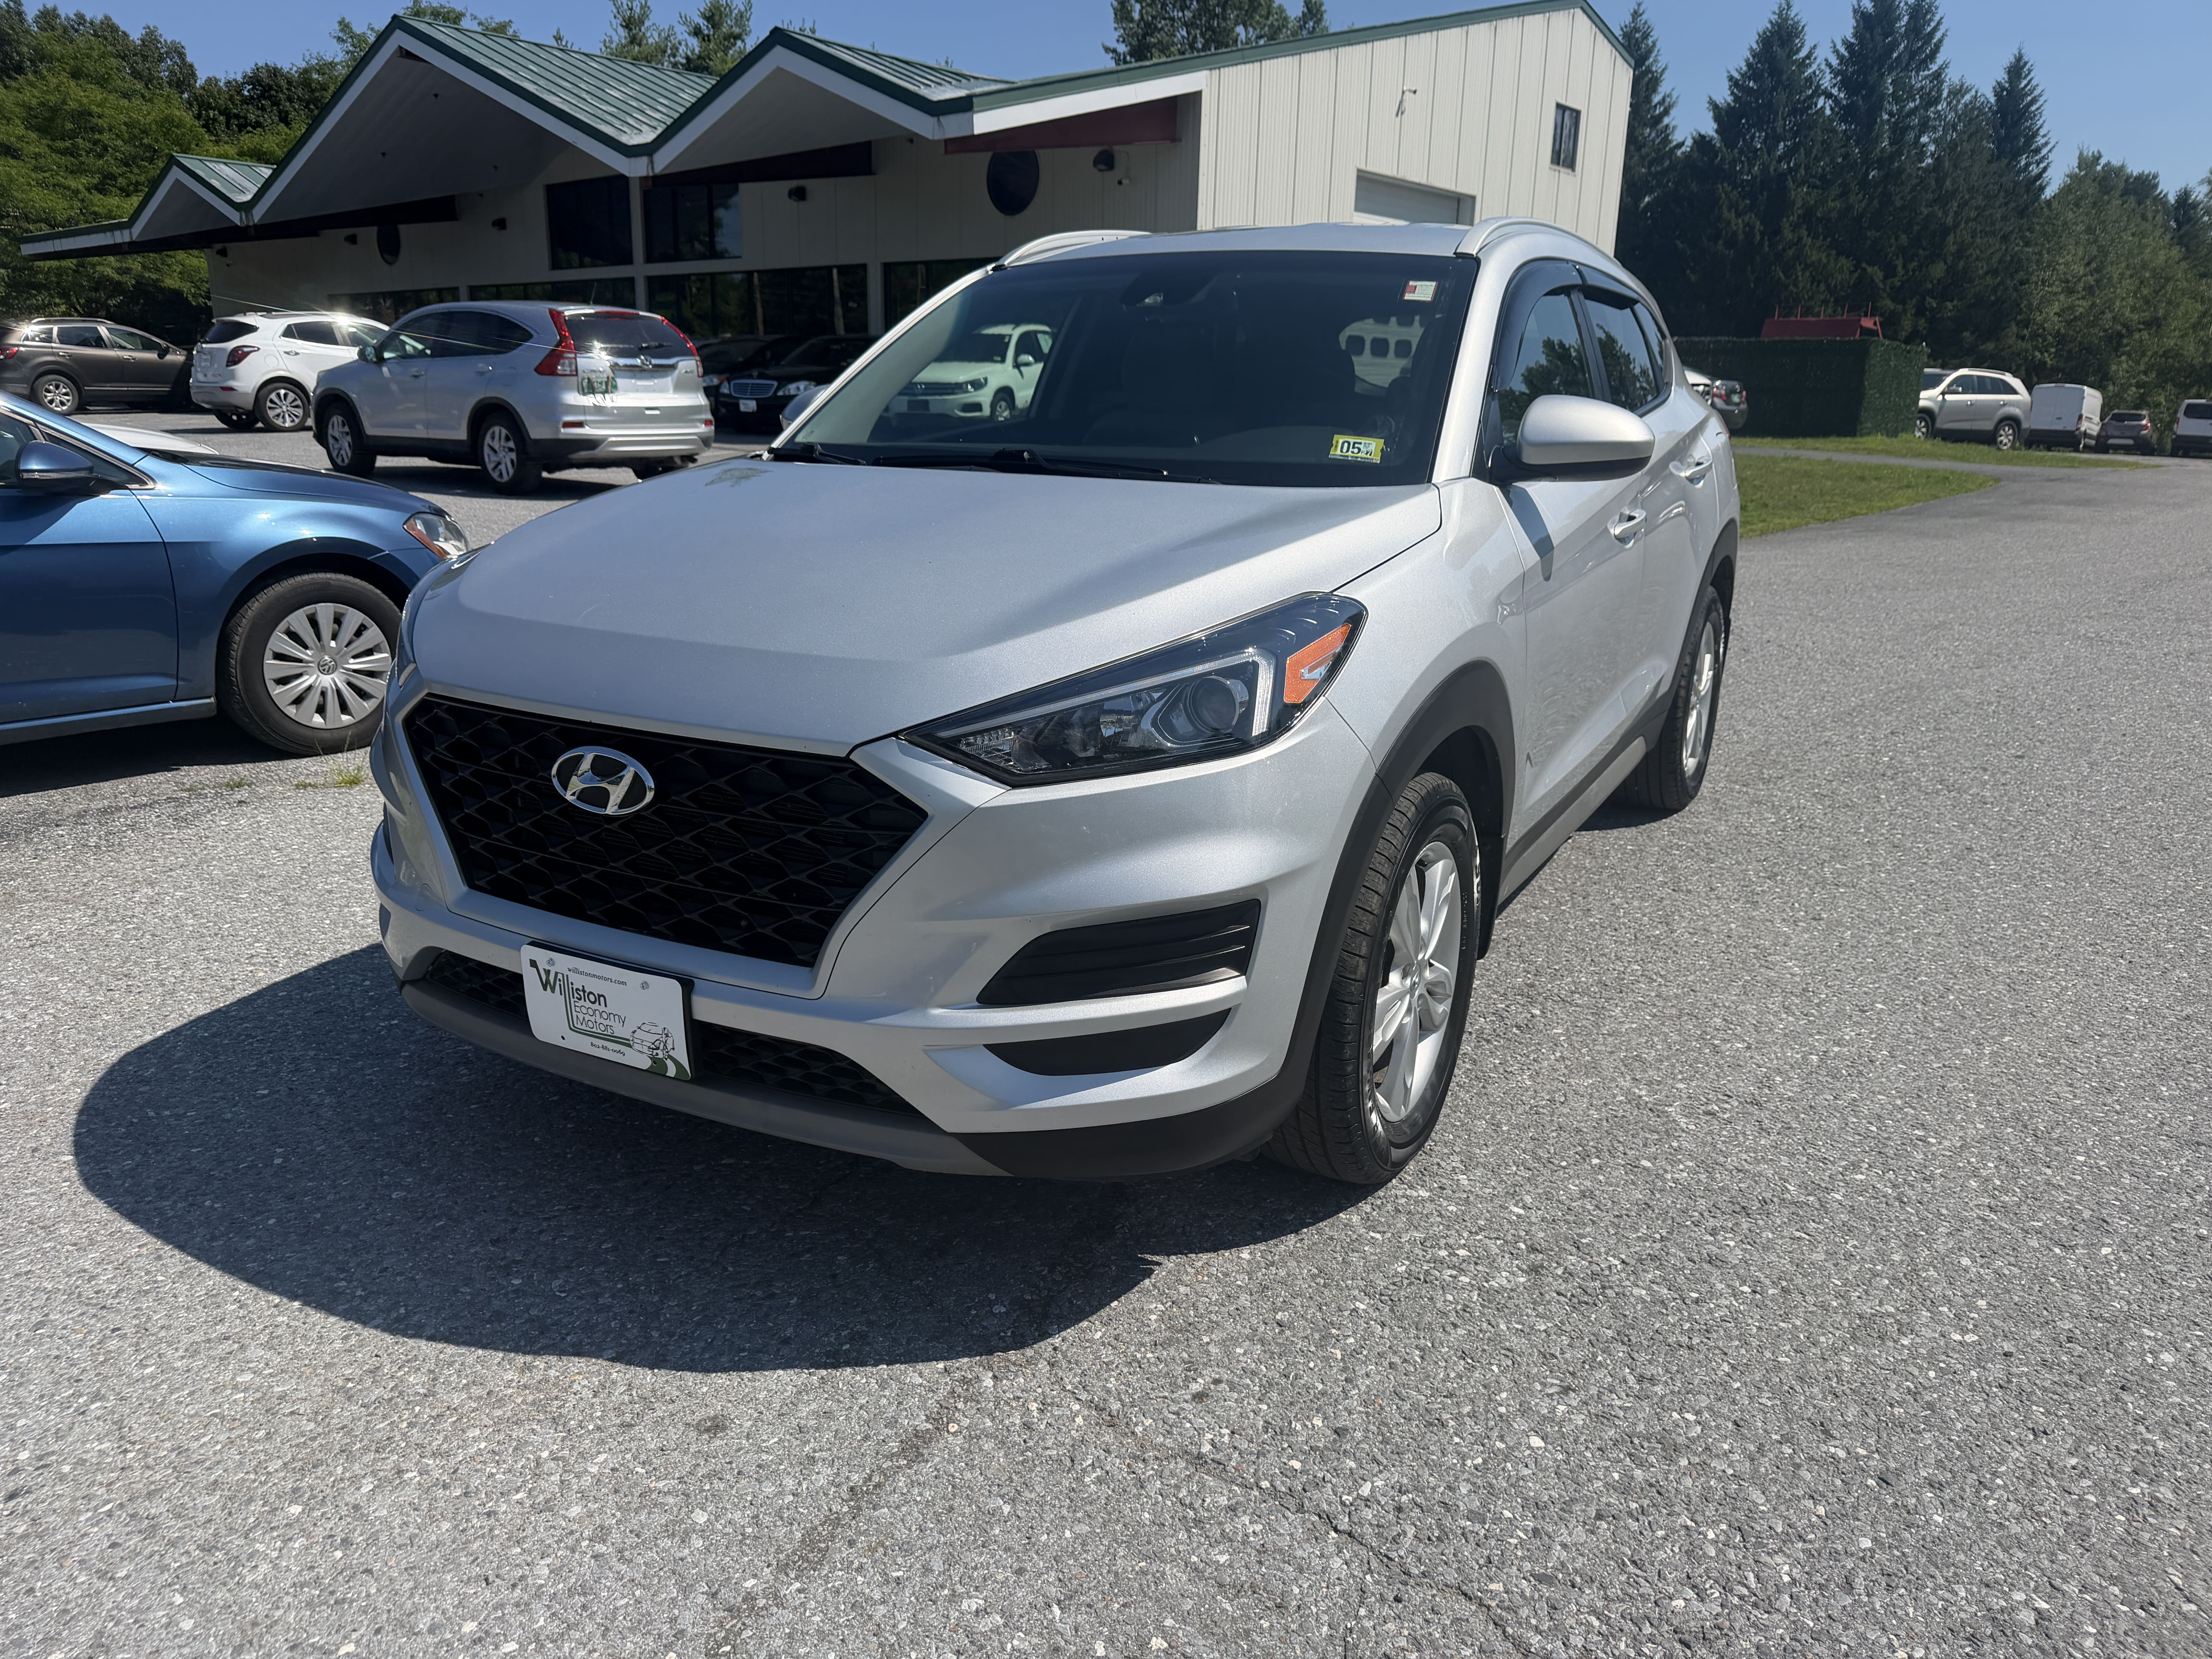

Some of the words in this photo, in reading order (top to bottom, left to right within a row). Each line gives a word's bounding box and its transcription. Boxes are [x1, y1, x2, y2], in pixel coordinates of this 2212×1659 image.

[1340, 440, 1362, 454] 05
[529, 958, 608, 1008] Williston
[567, 966, 627, 986] willistonmotors.com
[574, 1001, 626, 1027] Economy
[576, 1014, 615, 1035] Motors
[590, 1042, 625, 1056] 802-881-0069
